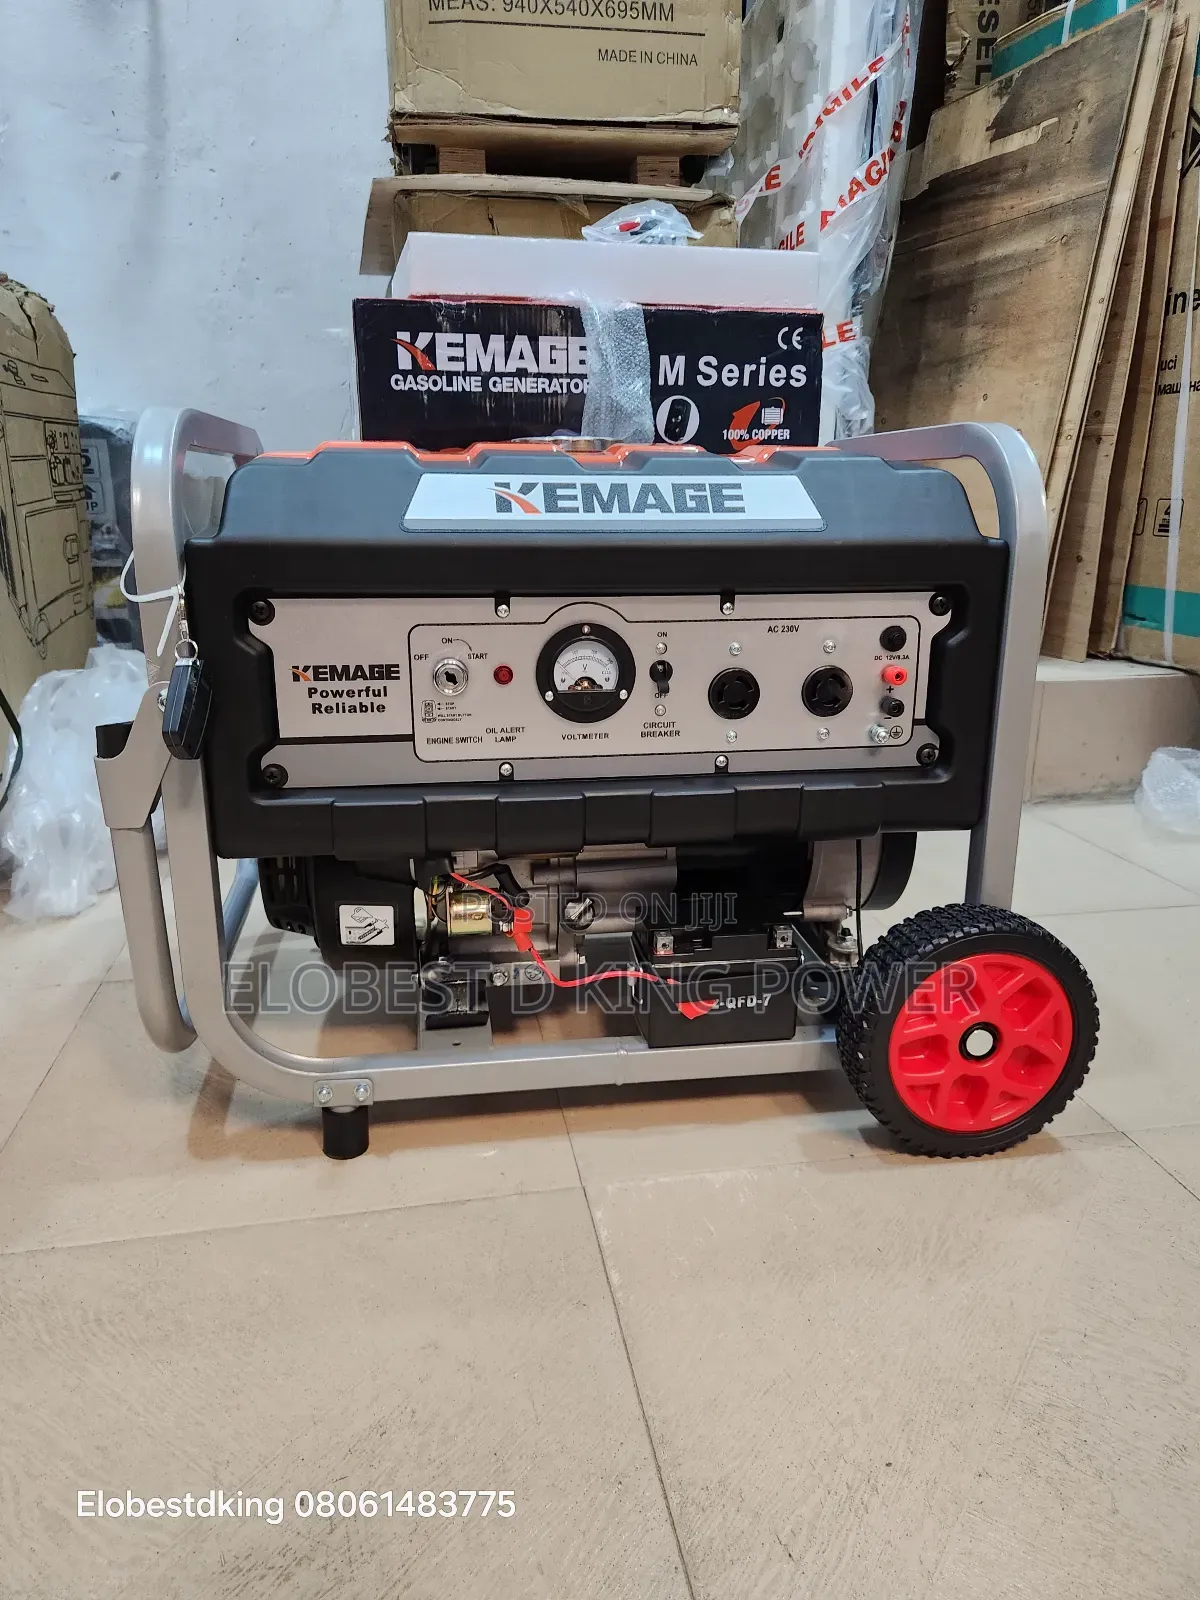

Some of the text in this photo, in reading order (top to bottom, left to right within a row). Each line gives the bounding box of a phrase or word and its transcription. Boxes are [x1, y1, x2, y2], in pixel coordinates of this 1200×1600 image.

[428, 0, 675, 22] MEAS: 940X540X695MM
[598, 48, 698, 66] MADE IN CHINA
[390, 331, 588, 374] KEMAGE
[658, 354, 808, 388] M Series
[390, 374, 483, 392] GASOLINE
[722, 428, 791, 440] 100% COPPER
[488, 481, 746, 514] KEMAGE
[767, 625, 800, 634] AC 230V
[441, 637, 453, 645] ON
[413, 653, 430, 661] OFF
[467, 652, 488, 660] START
[288, 664, 401, 683] KEMAGE
[307, 686, 388, 699] Powerful
[311, 701, 386, 715] Reliable
[426, 736, 483, 745] ENGINE SWITCH
[561, 732, 610, 741] VOLTMETER
[640, 730, 681, 738] BREAKER
